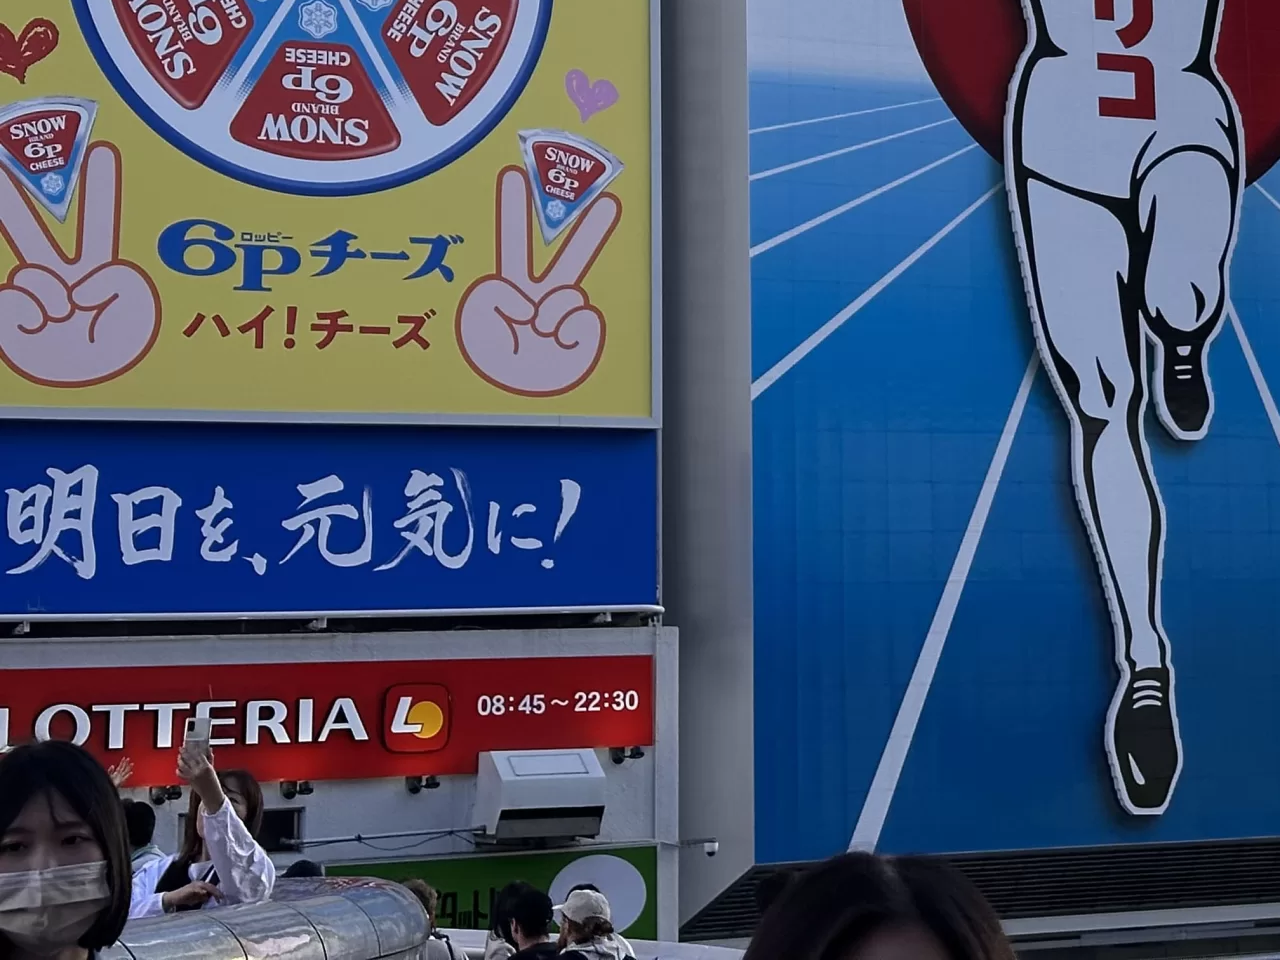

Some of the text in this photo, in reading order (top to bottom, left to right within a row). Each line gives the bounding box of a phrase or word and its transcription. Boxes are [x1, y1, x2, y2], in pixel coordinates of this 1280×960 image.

[407, 0, 458, 58] 6P
[434, 5, 502, 107] SNOW
[436, 22, 466, 64] BRAND
[285, 47, 351, 67] CHEESE
[281, 65, 354, 104] 6P
[291, 102, 340, 115] BRAND
[9, 114, 67, 141] SNOW
[257, 113, 369, 147] SNOW
[24, 142, 63, 159] 6P
[29, 157, 65, 171] CHEESE
[544, 146, 596, 173] SNOW
[545, 184, 576, 201] CHEESE
[547, 168, 580, 191] 6P
